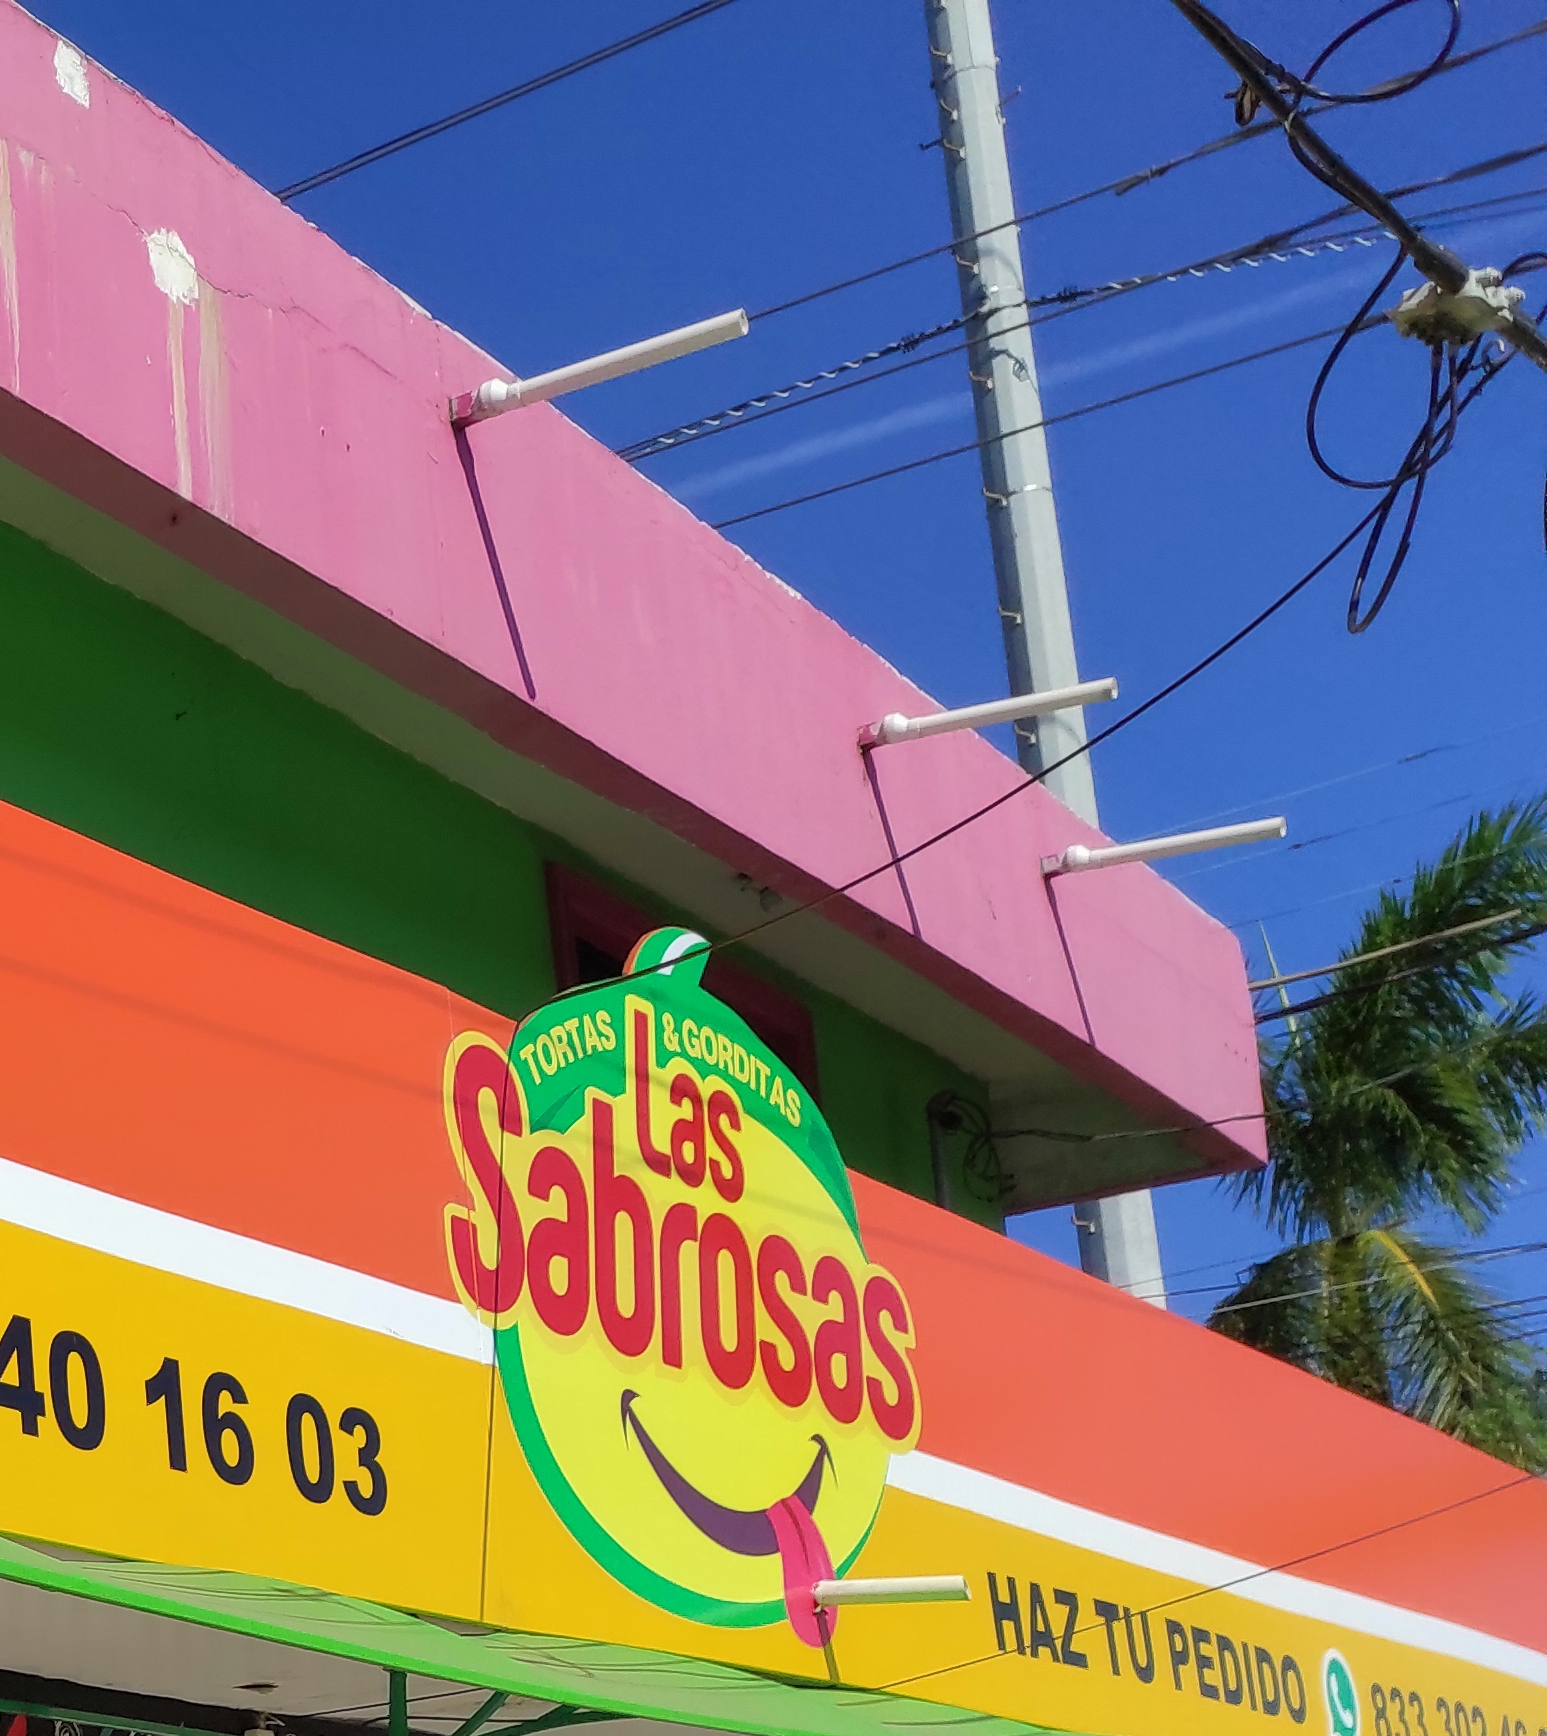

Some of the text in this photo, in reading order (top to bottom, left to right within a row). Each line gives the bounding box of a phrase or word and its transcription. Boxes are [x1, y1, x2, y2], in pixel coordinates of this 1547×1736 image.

[519, 1010, 616, 1087] TORTAS
[681, 1016, 802, 1130] GORDITAS
[633, 1008, 745, 1204] Las
[450, 1043, 914, 1442] Sabrosas
[144, 1357, 255, 1486] 16
[286, 1393, 389, 1517] 03
[987, 1571, 1089, 1670] HAZ
[1094, 1597, 1155, 1684] TU
[1165, 1617, 1308, 1725] PEDIDO
